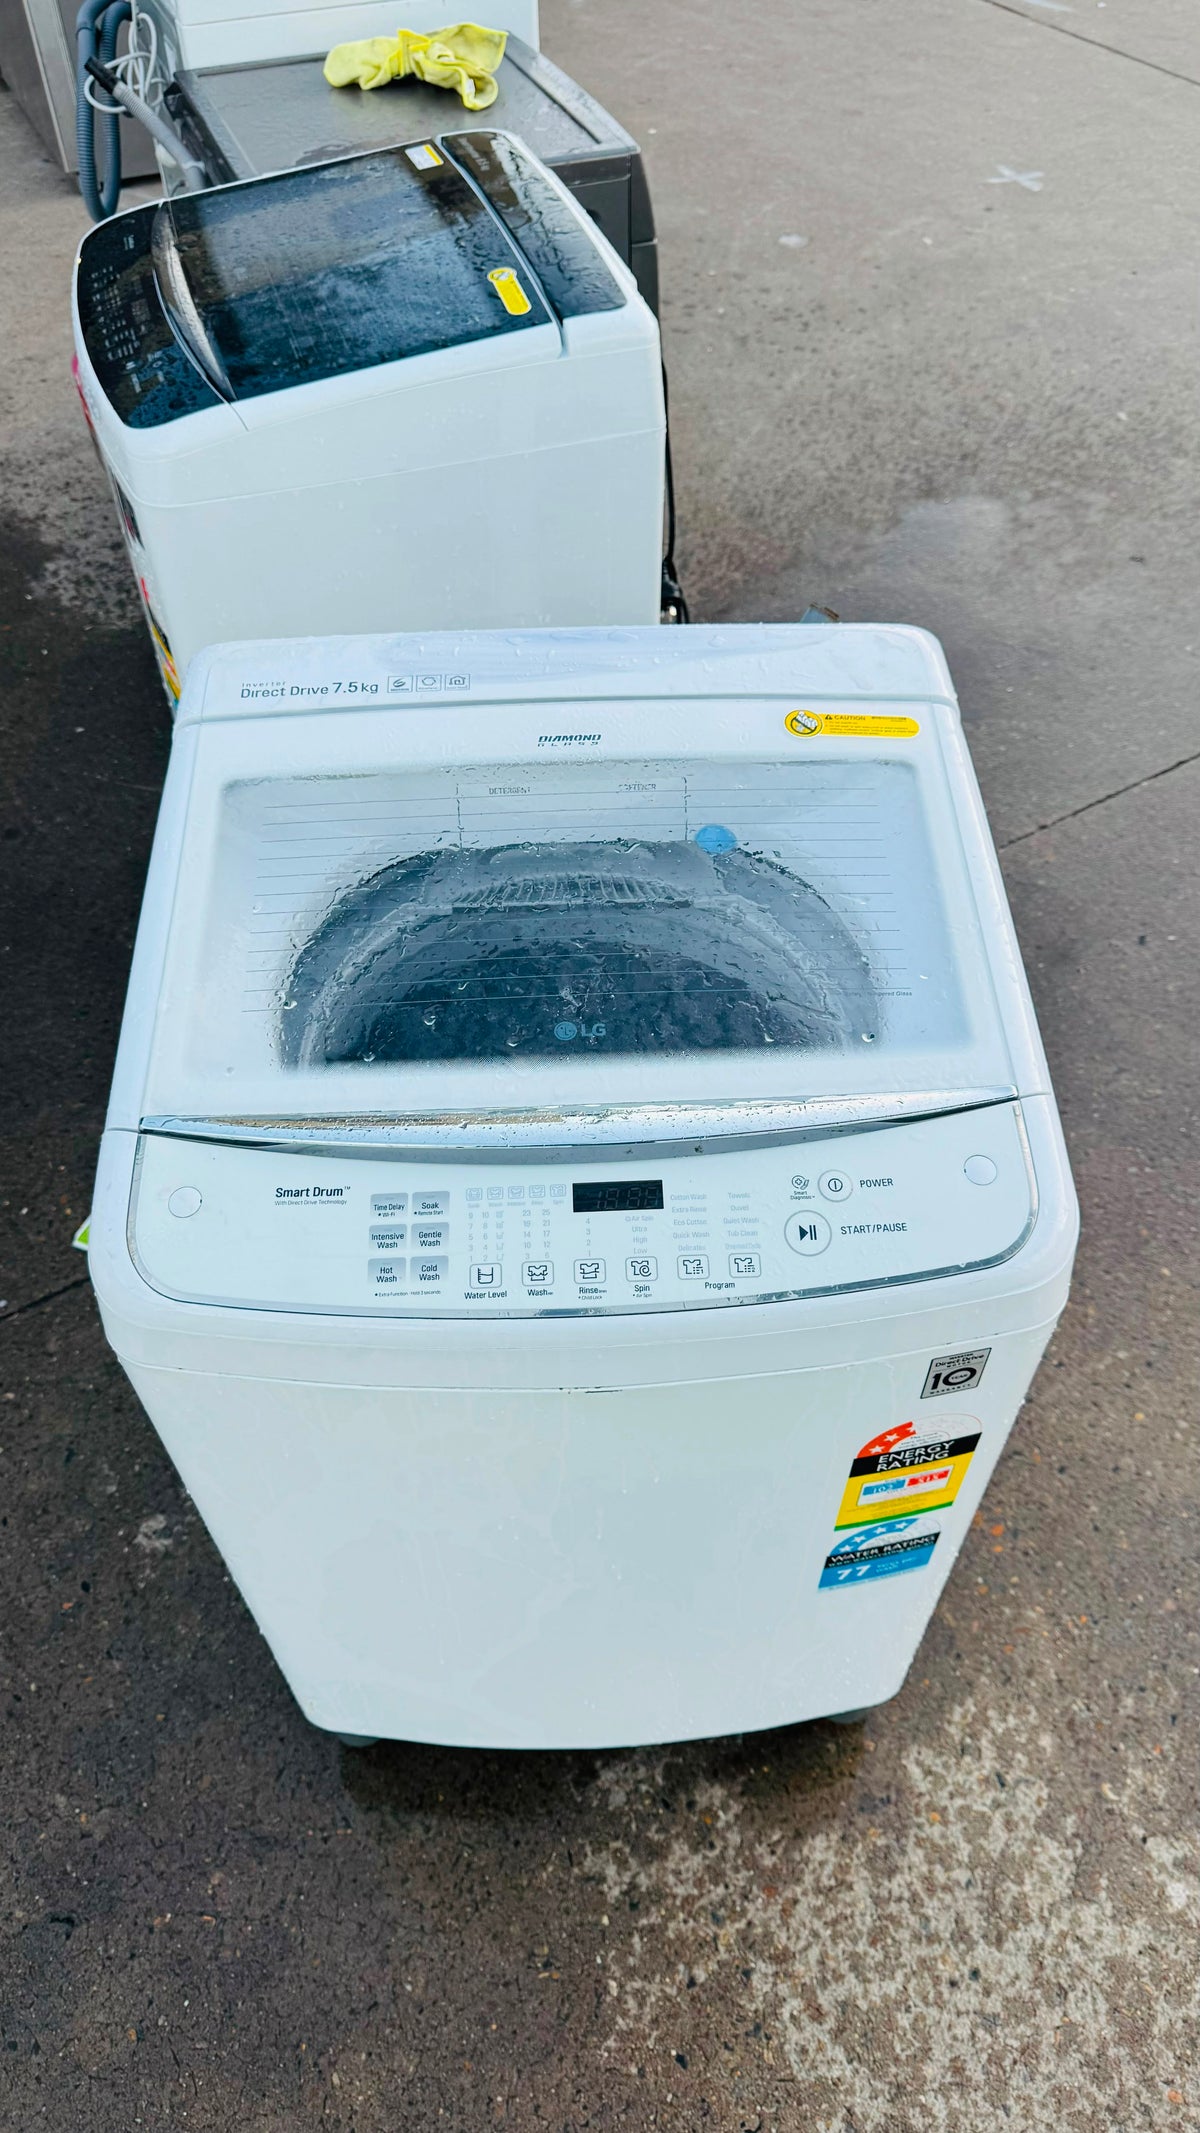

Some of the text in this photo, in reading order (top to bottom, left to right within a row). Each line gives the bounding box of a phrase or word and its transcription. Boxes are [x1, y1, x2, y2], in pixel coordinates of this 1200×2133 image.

[240, 681, 379, 699] Direct Drive 7.5 kg
[538, 734, 602, 743] DIAMOND
[581, 1023, 607, 1037] LG
[859, 1178, 894, 1188] POWER
[275, 1187, 310, 1198] Smart
[388, 1203, 405, 1211] Delay
[840, 1222, 908, 1235] START/PAUSE
[371, 1232, 405, 1241] Intensive
[418, 1230, 442, 1239] Gentle
[377, 1241, 398, 1249] Wash
[420, 1239, 441, 1247] Wash
[379, 1266, 393, 1274] Hot
[421, 1264, 438, 1272] Cold
[376, 1275, 398, 1283] Wash
[418, 1273, 440, 1281] Wash
[578, 1286, 599, 1294] Rinse
[634, 1284, 650, 1293] Spin
[704, 1281, 736, 1290] Program
[464, 1290, 508, 1300] Water Level
[527, 1288, 548, 1297] Wash
[931, 1367, 977, 1390] 10
[878, 1440, 955, 1464] ENERGY
[876, 1450, 950, 1472] RATING
[831, 1536, 936, 1563] WATER RATING
[837, 1564, 871, 1580] 77
